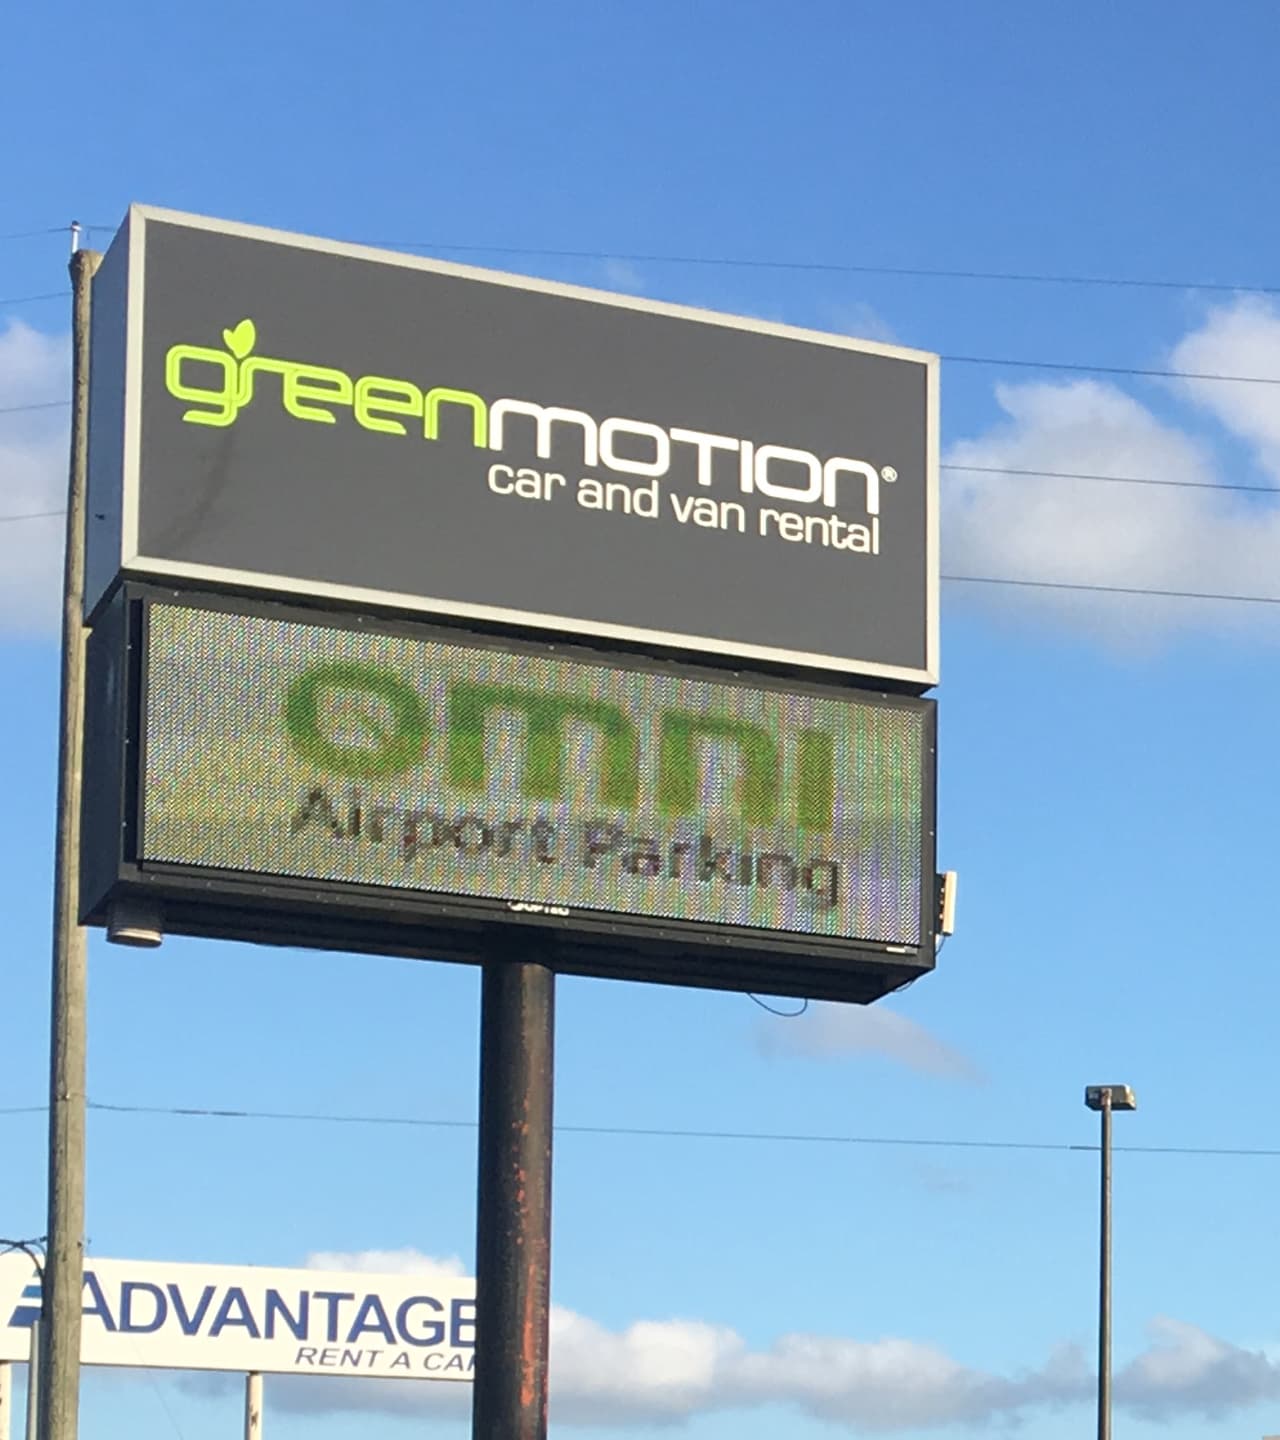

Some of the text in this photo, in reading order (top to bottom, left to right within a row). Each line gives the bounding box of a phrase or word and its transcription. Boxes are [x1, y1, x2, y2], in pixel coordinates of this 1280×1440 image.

[487, 464, 880, 555] car and van rental
[292, 790, 840, 908] Airport Parking
[80, 1270, 477, 1347] ADVANTAGE
[294, 1345, 384, 1368] RENT
[389, 1352, 412, 1371] A
